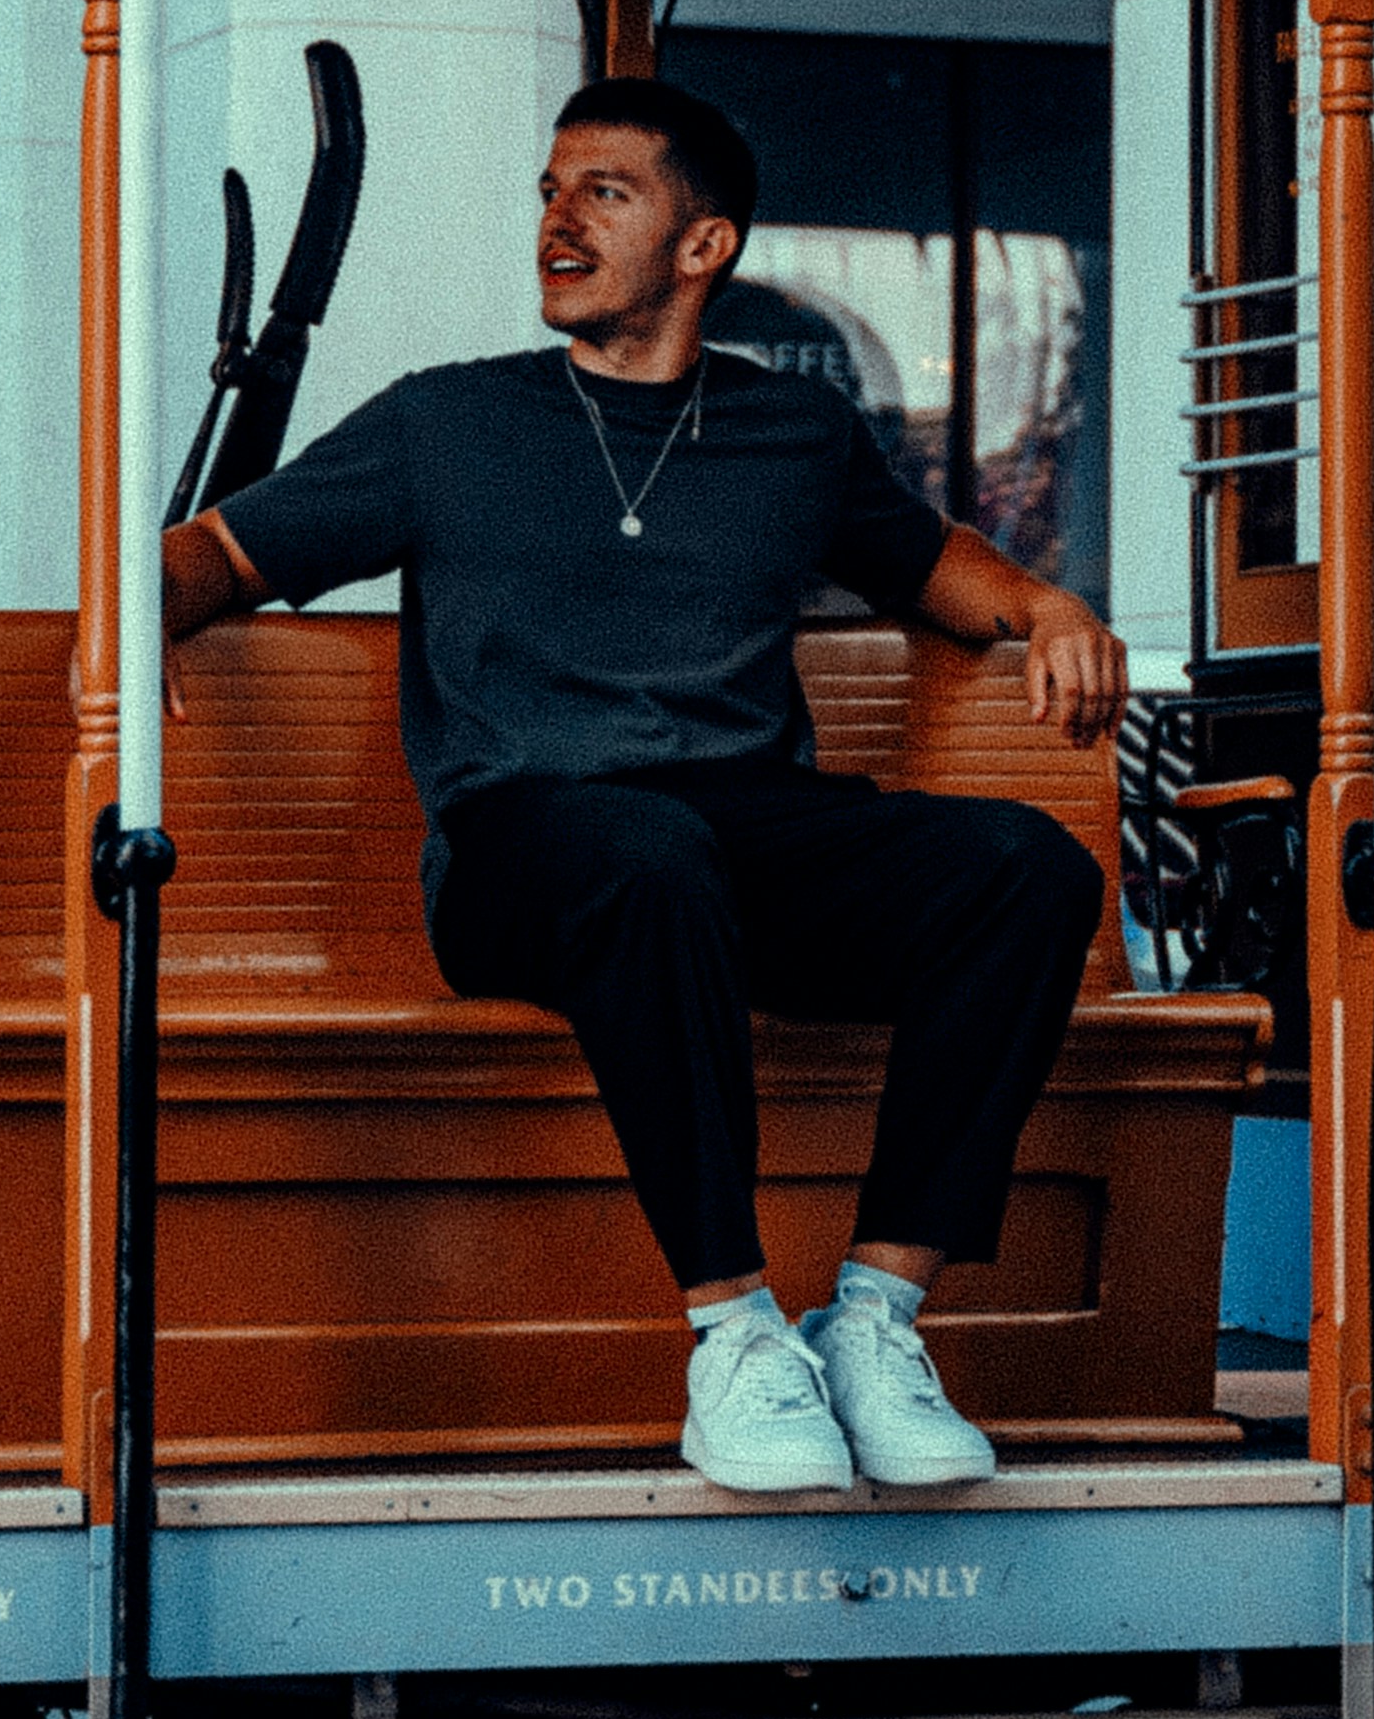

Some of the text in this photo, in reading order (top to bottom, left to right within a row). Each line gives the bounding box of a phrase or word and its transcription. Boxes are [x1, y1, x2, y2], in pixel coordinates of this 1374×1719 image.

[485, 1563, 983, 1612] TWO STANDEES ONLY
